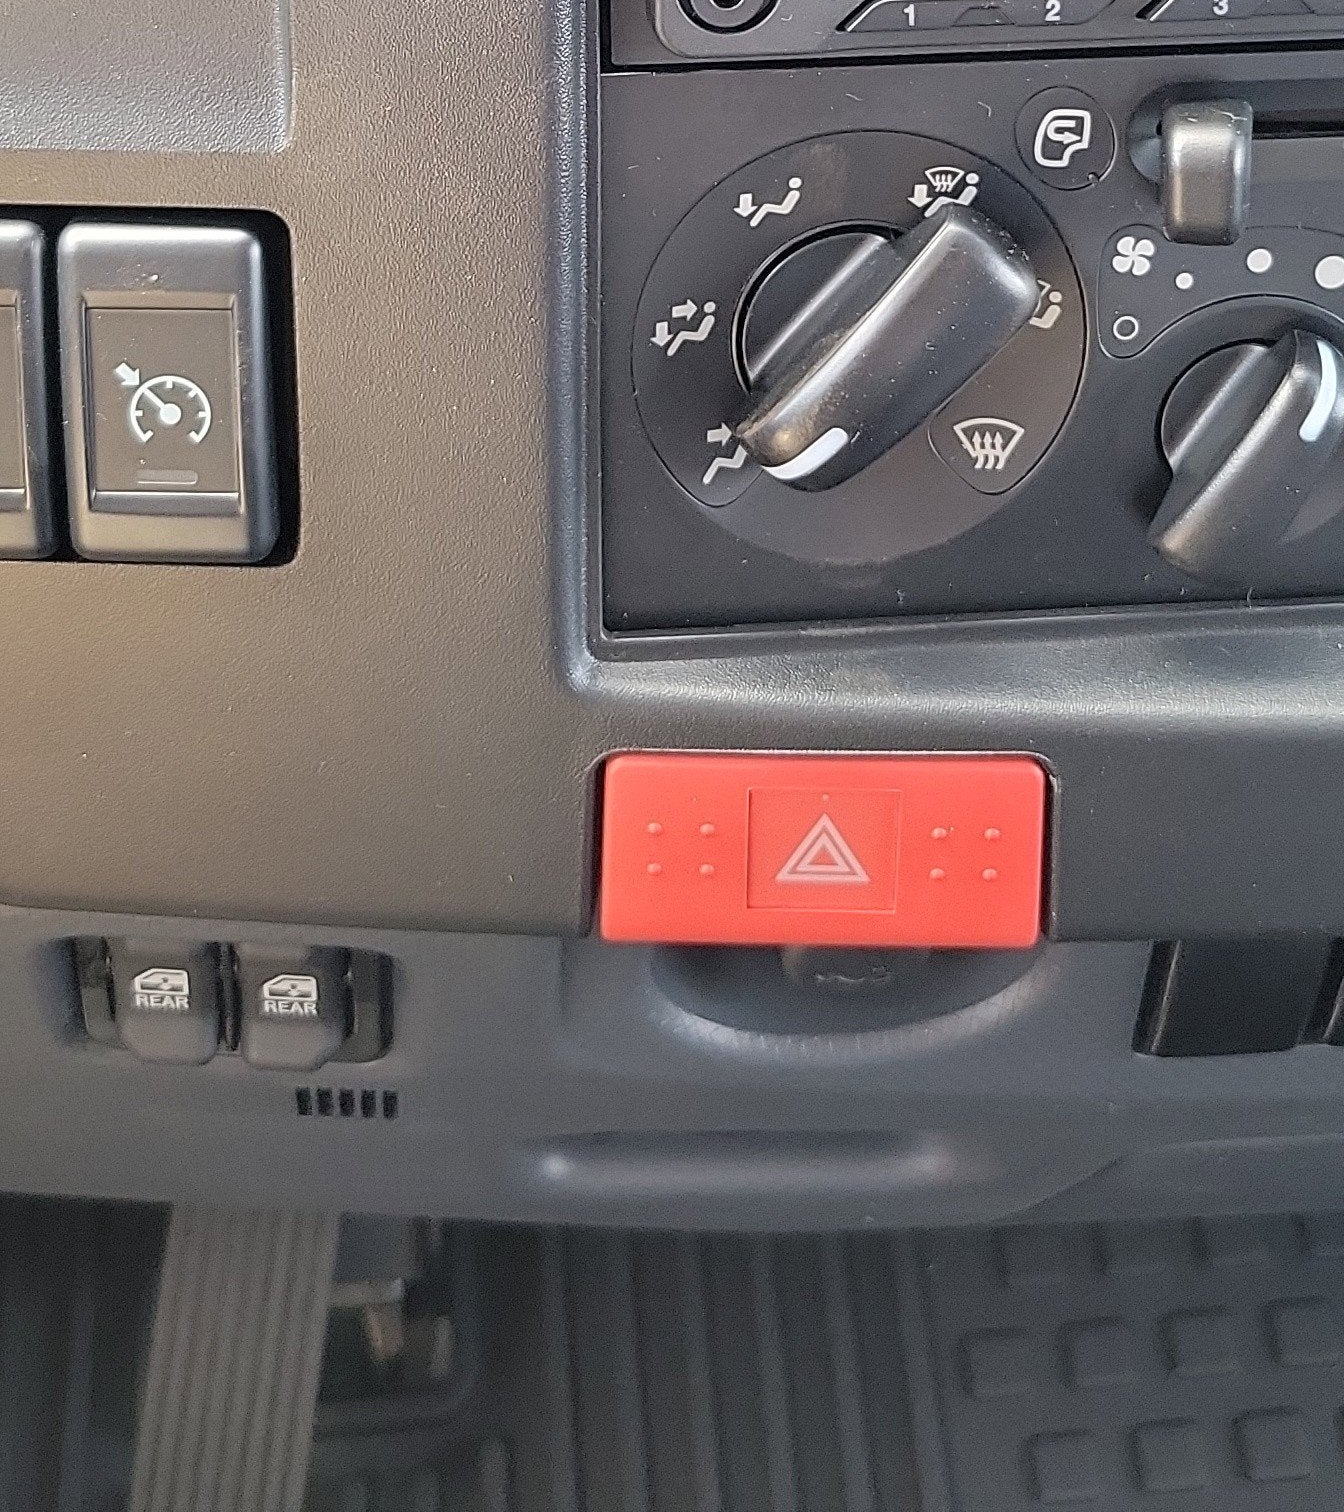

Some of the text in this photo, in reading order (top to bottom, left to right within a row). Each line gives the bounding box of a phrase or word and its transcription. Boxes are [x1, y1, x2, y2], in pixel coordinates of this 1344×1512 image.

[902, 2, 917, 27] 1
[134, 993, 190, 1010] REAR
[263, 999, 318, 1016] REAR
